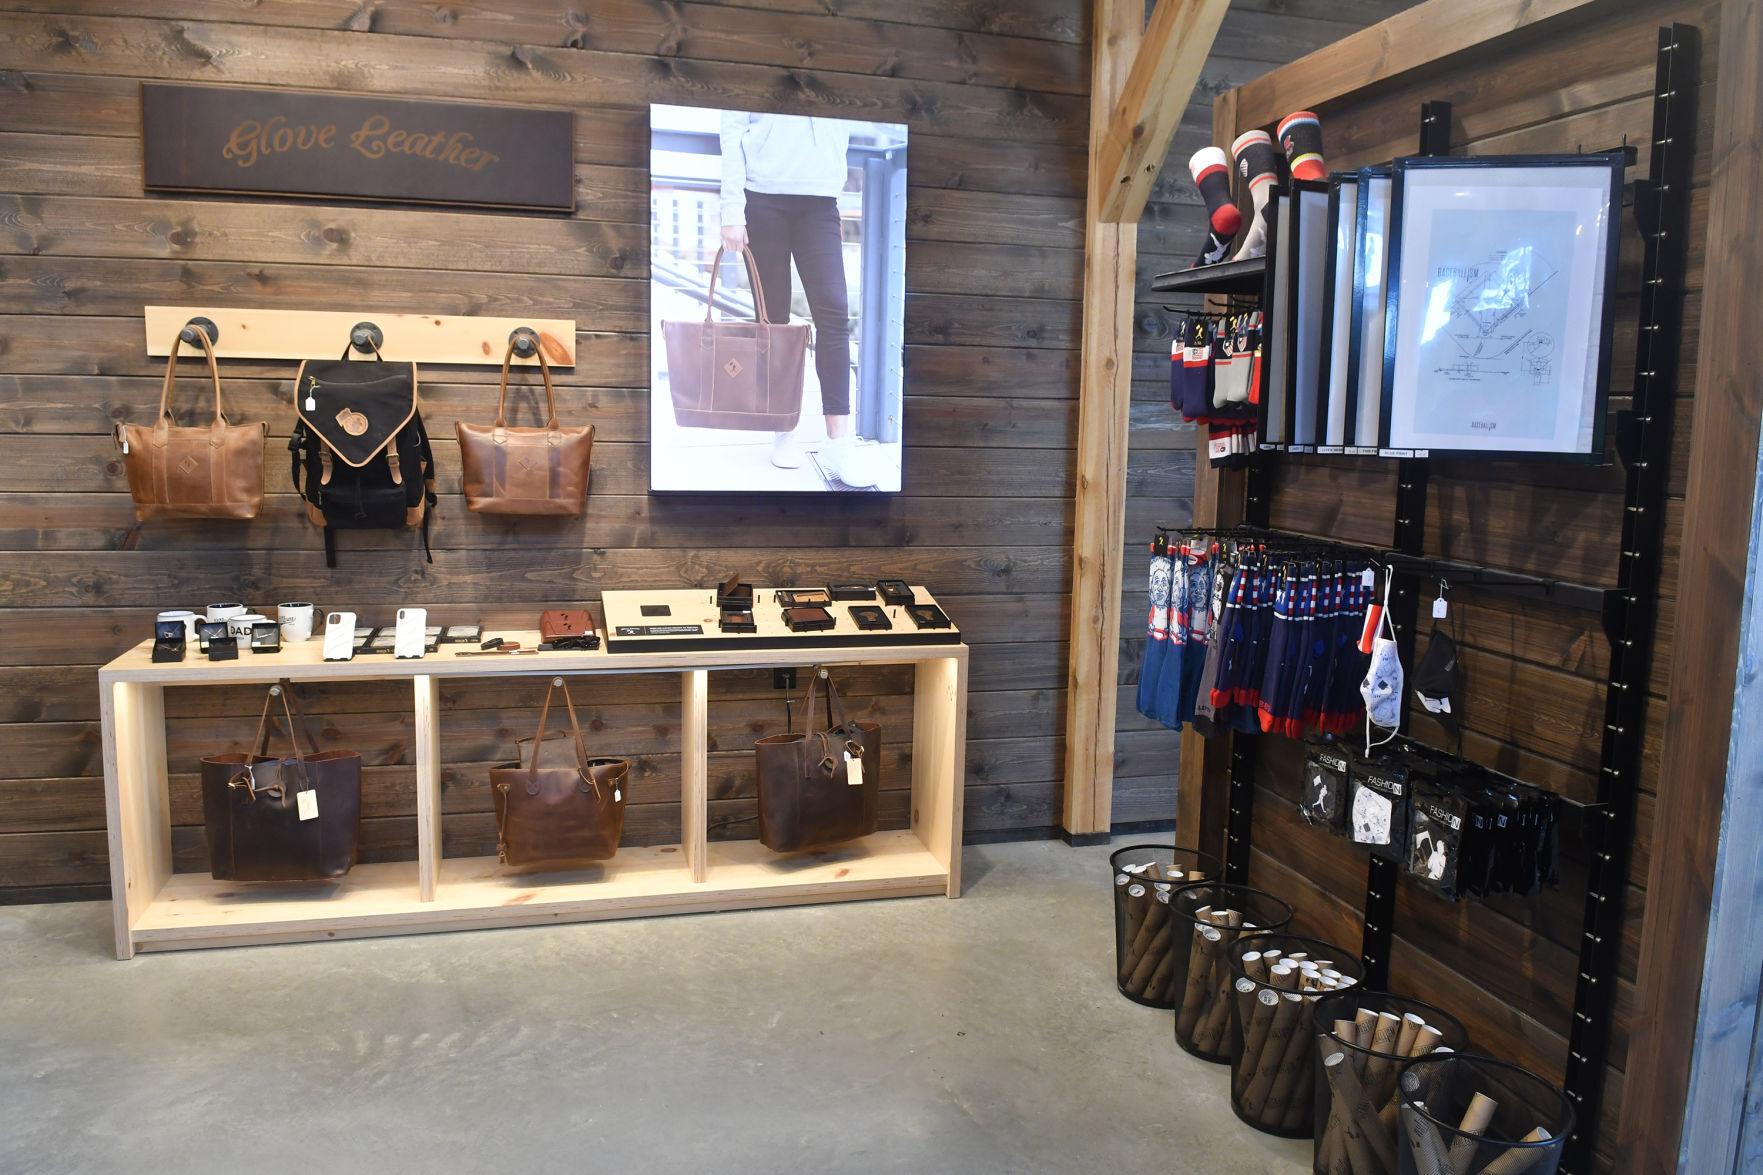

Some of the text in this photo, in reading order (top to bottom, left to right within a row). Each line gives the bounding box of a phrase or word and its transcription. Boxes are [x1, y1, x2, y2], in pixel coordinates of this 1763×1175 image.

[223, 115, 500, 171] Glove Leather
[230, 626, 252, 636] DAD
[1319, 753, 1347, 773] FASHION
[1367, 775, 1402, 796] FASHION
[1429, 805, 1462, 831] FASHION
